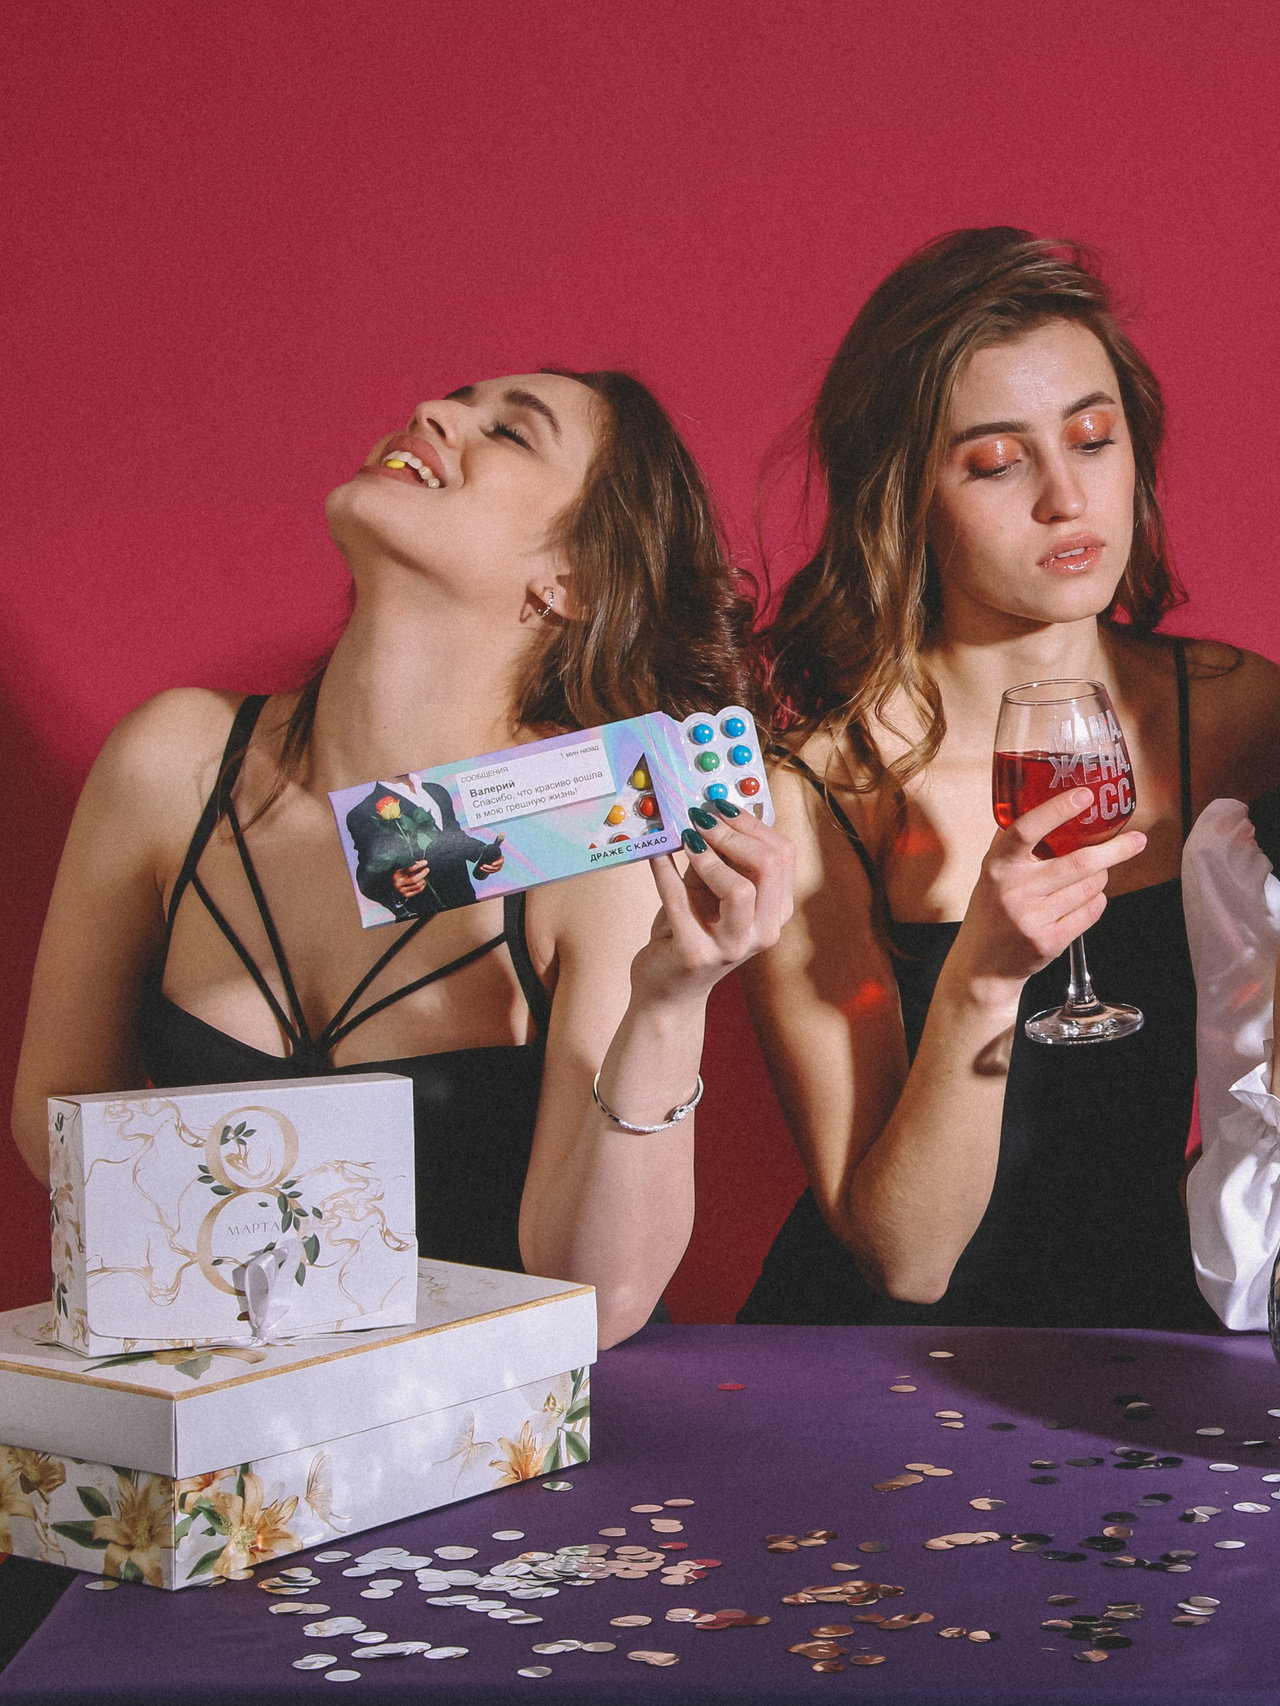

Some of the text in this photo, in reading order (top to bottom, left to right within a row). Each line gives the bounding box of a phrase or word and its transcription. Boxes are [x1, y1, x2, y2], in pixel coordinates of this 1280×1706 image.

[580, 745, 600, 756] назад
[460, 766, 509, 784] СООБЩЕНИЯ
[1048, 742, 1131, 788] ЖЕНА.
[469, 779, 516, 798] Валерий
[472, 770, 604, 809] Спасибо, что красиво вошла
[475, 787, 578, 820] в мою грешную жизнь!
[590, 836, 668, 863] ДРАЖЕ С КАКАО
[226, 1221, 281, 1236] МАРТА
